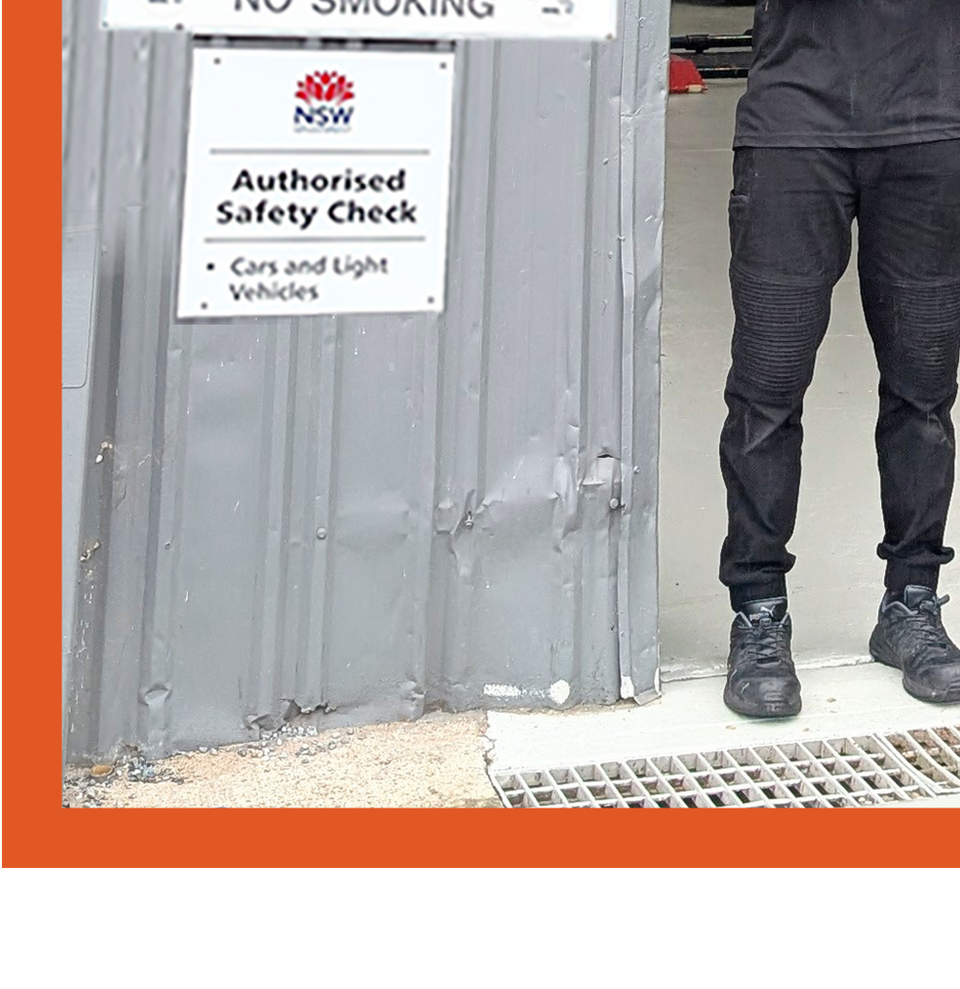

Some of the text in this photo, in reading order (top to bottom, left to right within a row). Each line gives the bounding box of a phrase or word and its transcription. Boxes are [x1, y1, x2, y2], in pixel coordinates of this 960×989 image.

[293, 104, 355, 127] NSW
[231, 168, 406, 193] Authorised
[216, 198, 418, 231] Safety Check
[230, 255, 389, 280] Cars and Light
[228, 281, 320, 303] Vehicles
